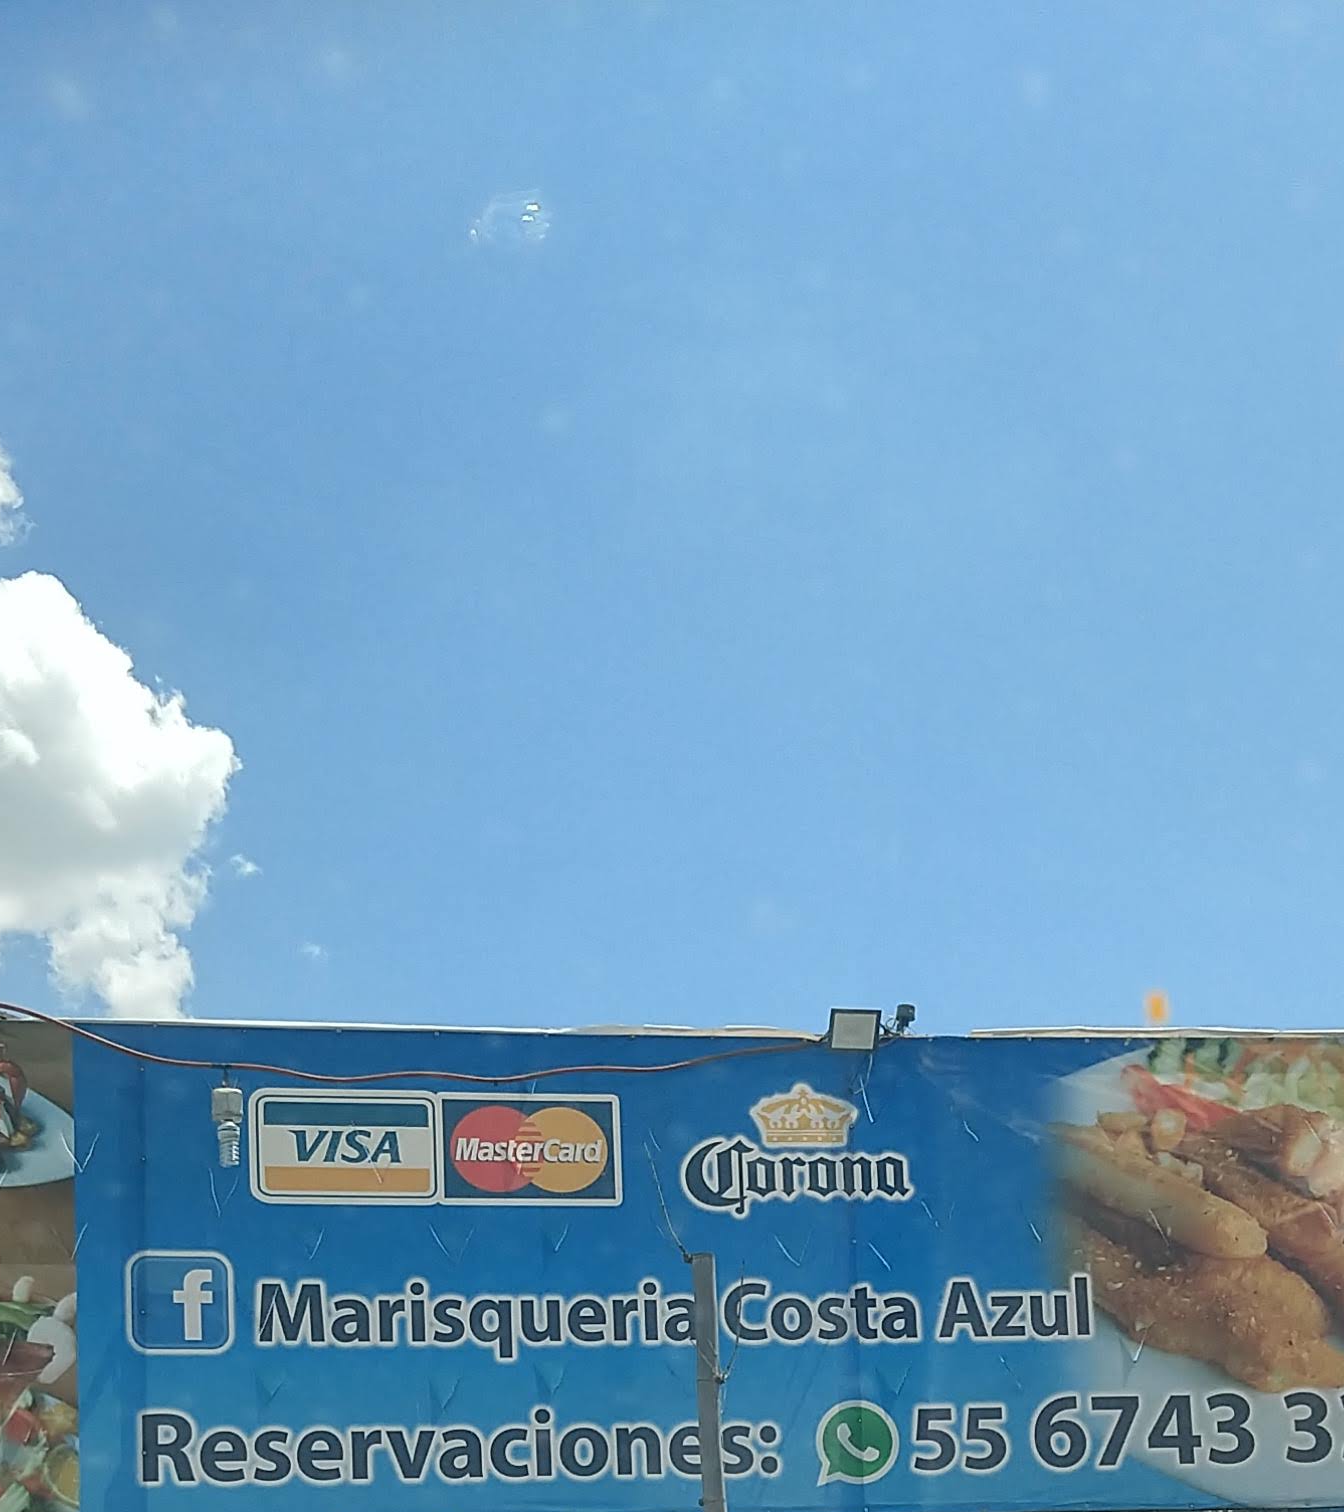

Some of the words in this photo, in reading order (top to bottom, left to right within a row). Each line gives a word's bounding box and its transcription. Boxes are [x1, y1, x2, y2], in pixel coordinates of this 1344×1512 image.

[287, 1129, 402, 1165] VISA
[454, 1136, 603, 1165] MasterCard
[685, 1137, 909, 1214] Corona
[259, 1282, 698, 1360] Marisqueria
[725, 1280, 918, 1342] Costa
[941, 1276, 1091, 1338] Azul
[142, 1409, 780, 1484] Reservaciones:
[913, 1408, 1006, 1471] 55
[1036, 1396, 1254, 1470] 6743
